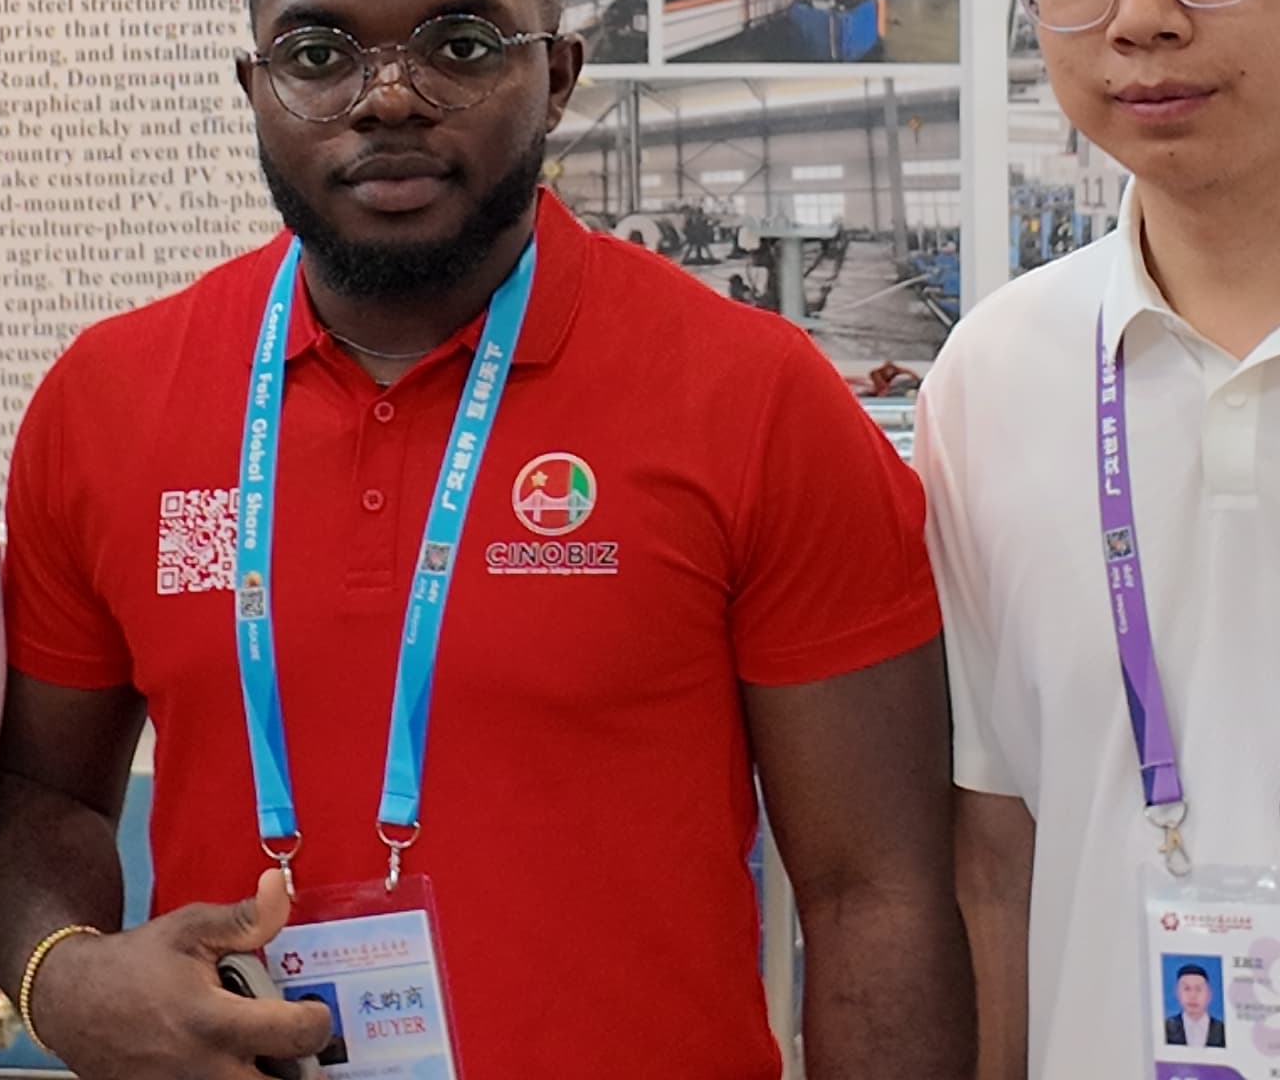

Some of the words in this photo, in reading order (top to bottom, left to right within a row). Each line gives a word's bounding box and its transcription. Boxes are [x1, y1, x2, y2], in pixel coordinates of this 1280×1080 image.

[64, 18, 109, 38] that
[119, 17, 236, 40] integrates
[67, 68, 219, 91] Dongmaquan
[109, 92, 223, 114] advantage
[5, 241, 144, 266] agricultural
[4, 292, 137, 316] capabilities
[261, 302, 284, 363] Canton
[255, 372, 272, 408] Fair
[247, 418, 269, 482] Global
[244, 492, 263, 550] Share
[486, 542, 618, 566] CINOBIZ
[366, 1015, 426, 1039] BUYER
